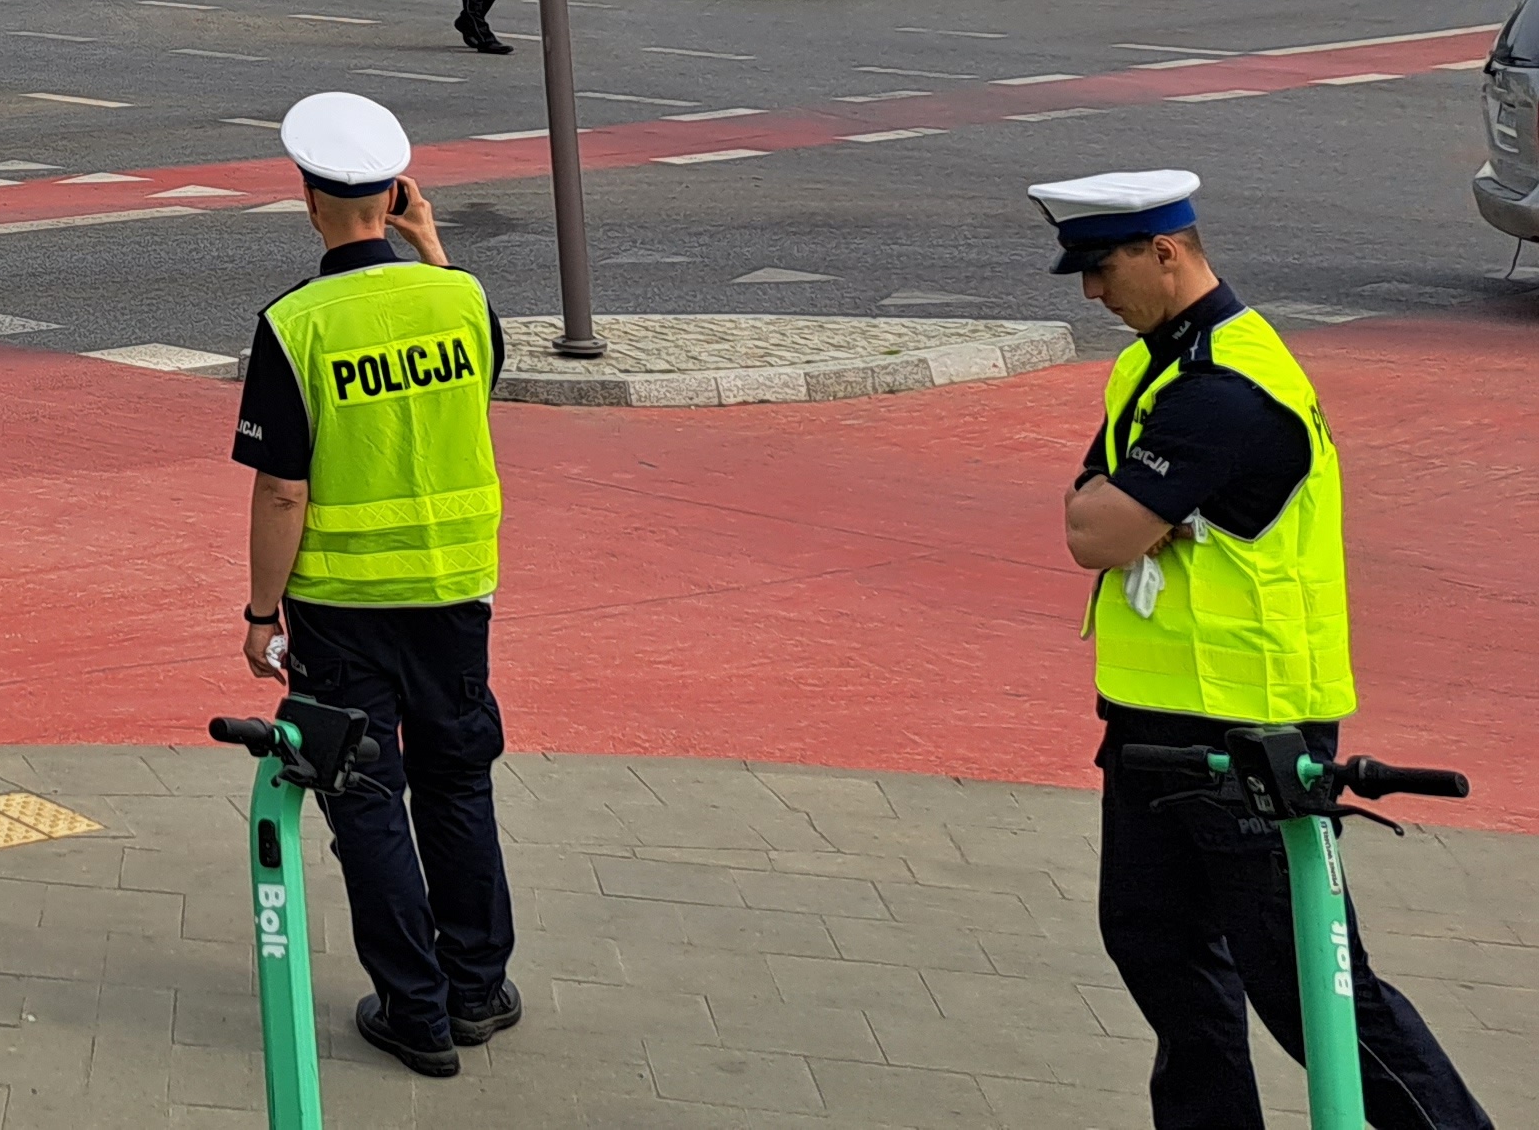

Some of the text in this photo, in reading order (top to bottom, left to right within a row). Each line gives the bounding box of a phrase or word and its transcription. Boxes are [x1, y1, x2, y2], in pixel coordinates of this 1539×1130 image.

[331, 339, 475, 401] POLICJA
[255, 883, 288, 959] Bolt
[1330, 920, 1353, 998] Bolt
